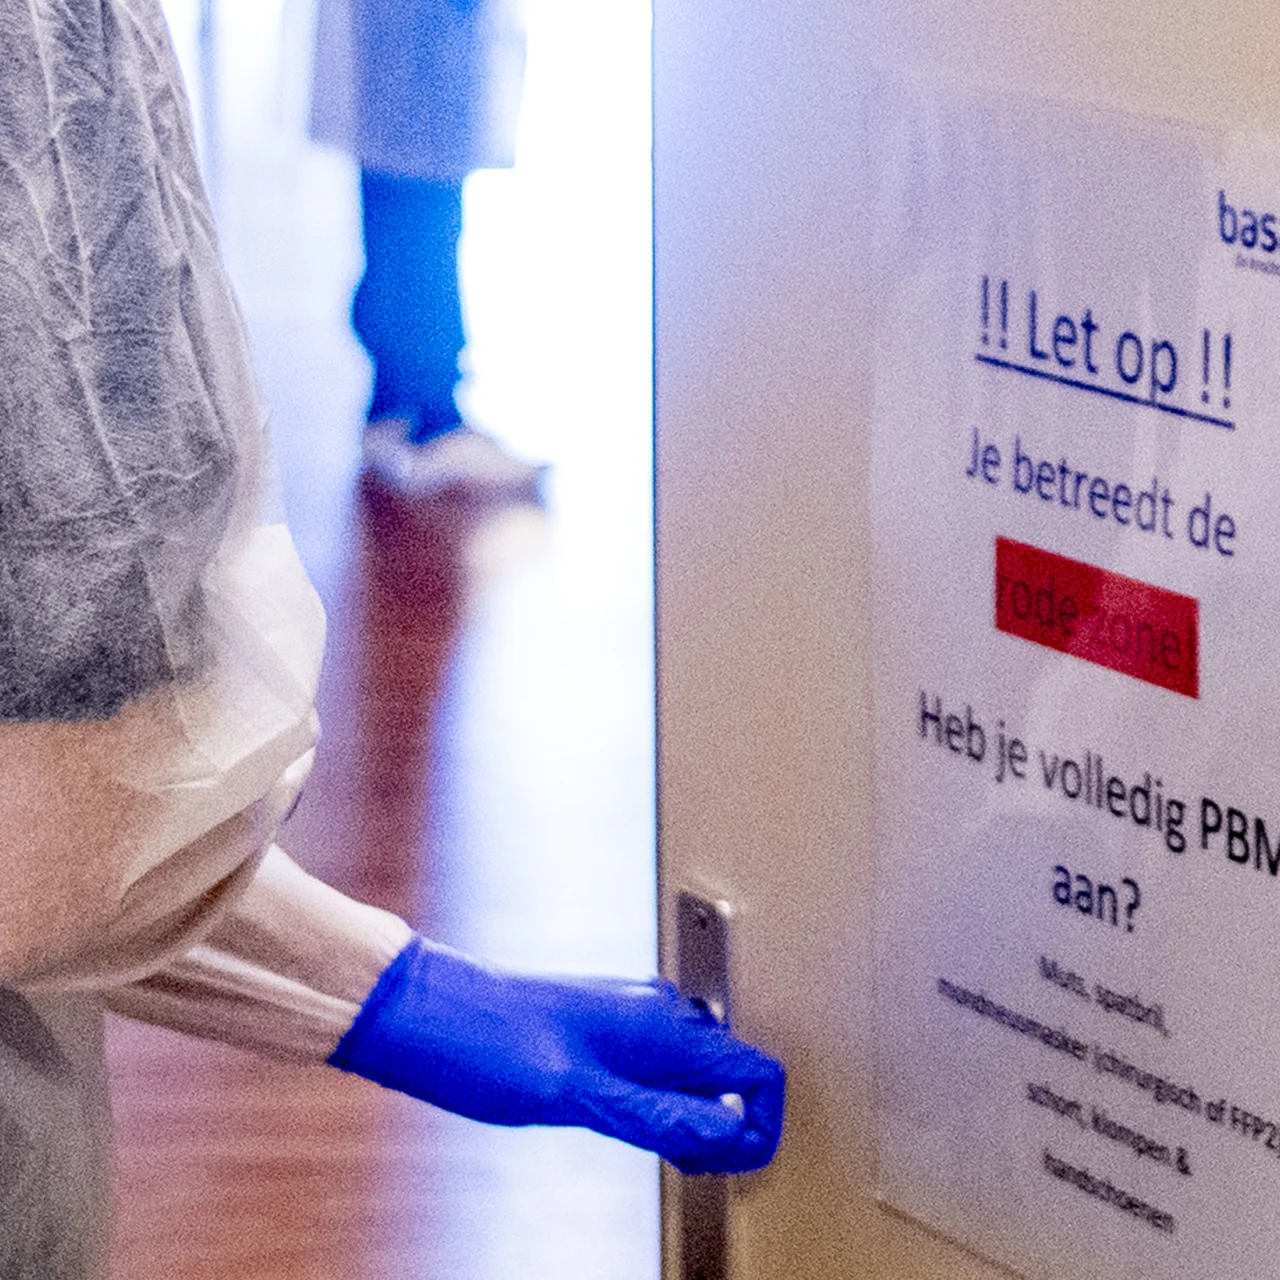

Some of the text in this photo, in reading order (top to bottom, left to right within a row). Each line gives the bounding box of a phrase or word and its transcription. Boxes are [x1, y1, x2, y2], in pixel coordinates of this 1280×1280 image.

[1029, 290, 1099, 374] Let
[1116, 331, 1178, 402] op
[965, 427, 1236, 557] Je betreedt de
[997, 573, 1079, 637] rode
[919, 689, 986, 764] Heb
[995, 720, 1029, 783] je
[1039, 750, 1187, 854] volledig
[1053, 864, 1142, 933] aan?
[1205, 1098, 1227, 1124] of
